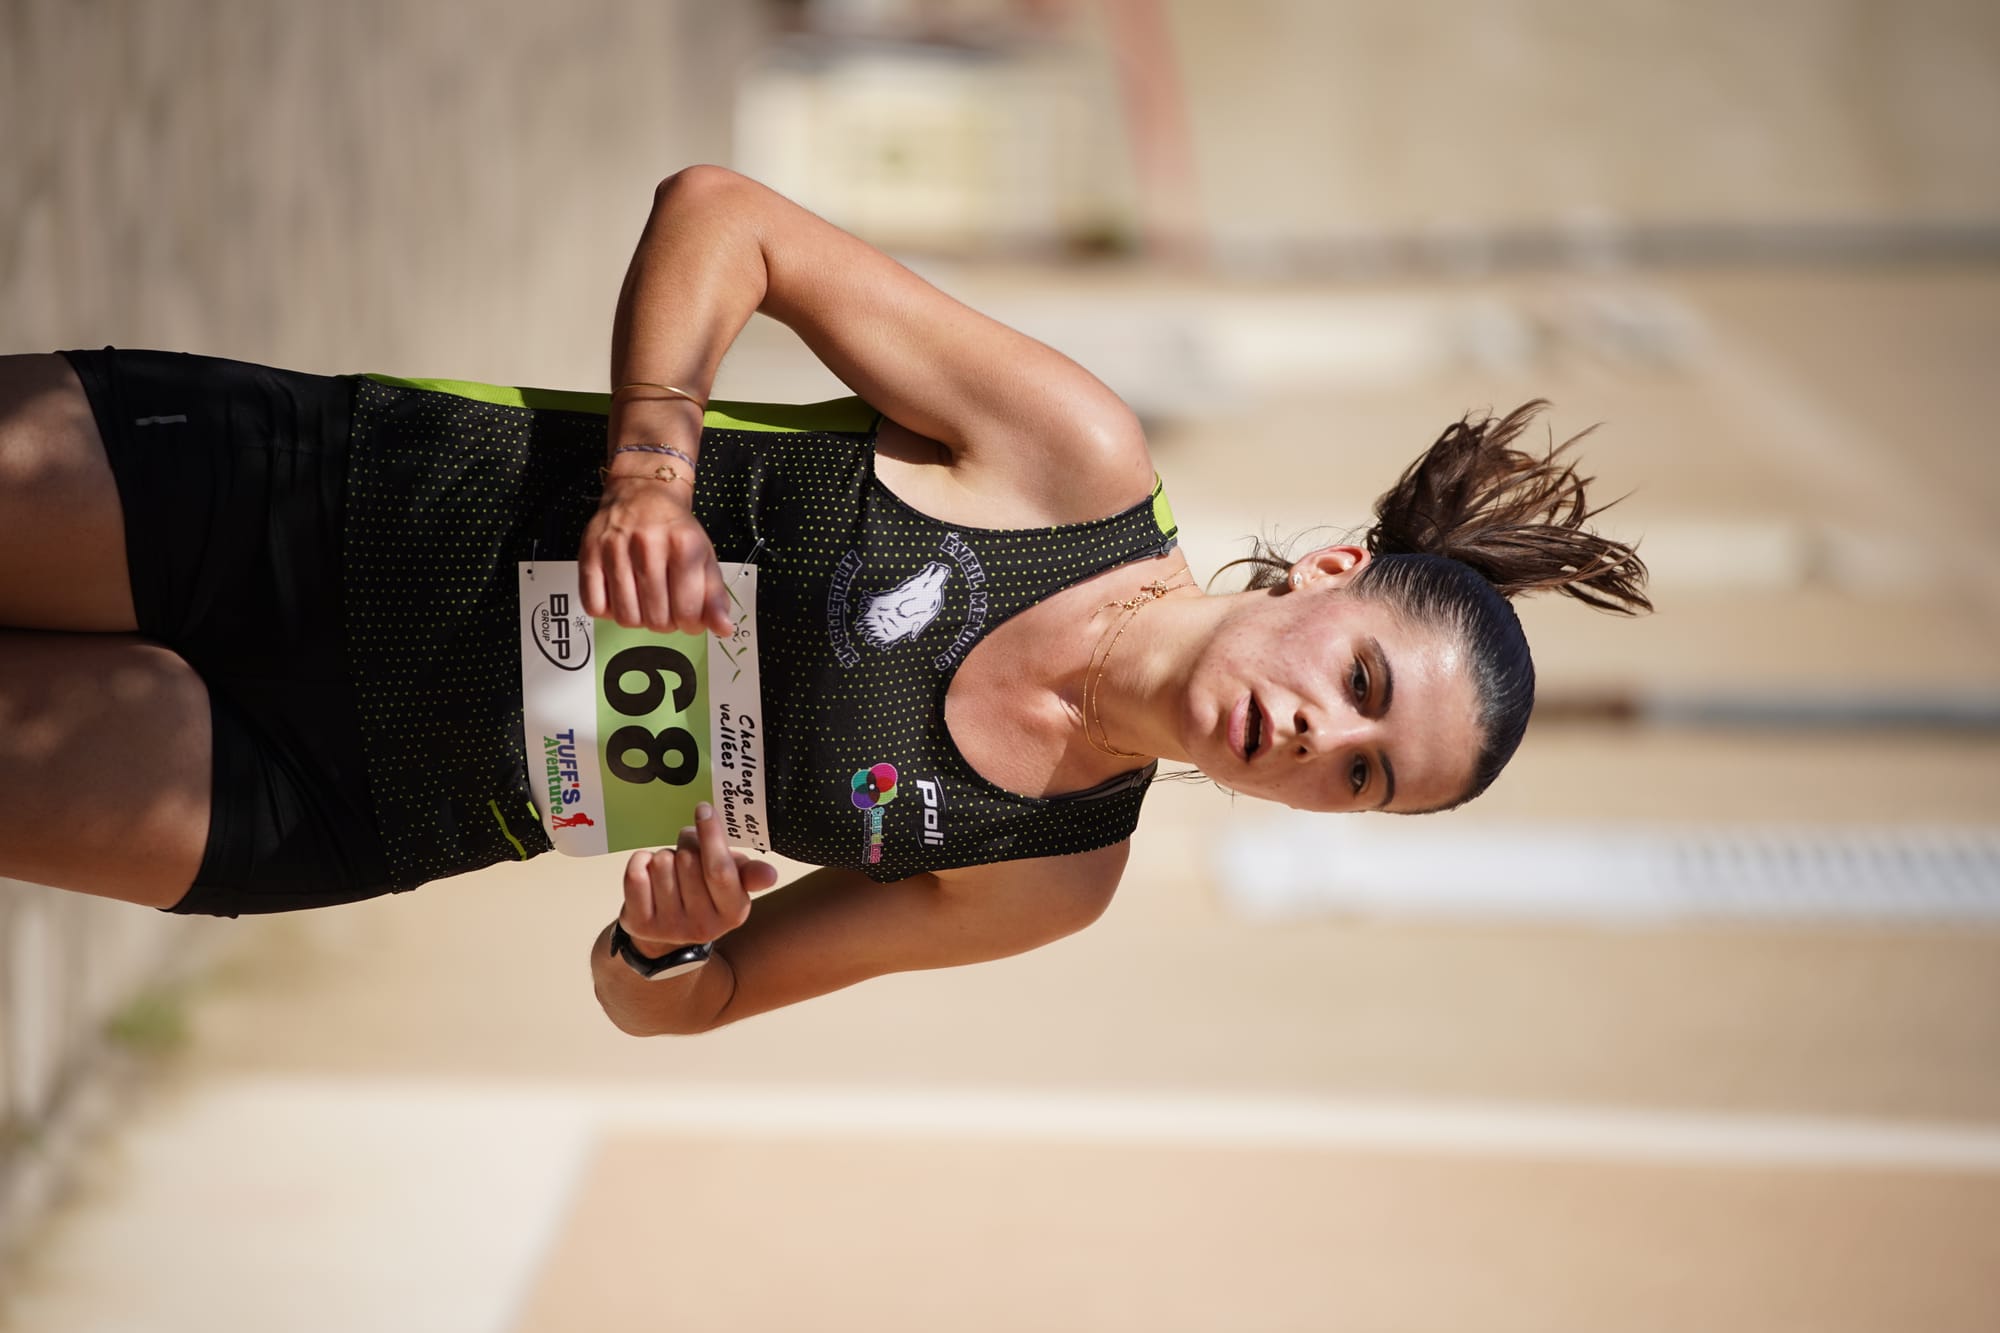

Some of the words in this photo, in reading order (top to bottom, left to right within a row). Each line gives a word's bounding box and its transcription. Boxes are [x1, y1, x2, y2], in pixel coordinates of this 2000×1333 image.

[940, 532, 986, 591] ÉVEIL
[540, 608, 551, 642] GROUP
[549, 593, 571, 660] BFP
[603, 645, 699, 786] 68
[720, 703, 738, 770] vallées
[543, 735, 564, 815] Aventure
[556, 728, 581, 805] TUFF'S
[737, 714, 757, 805] Challenge
[722, 781, 741, 839] cévenoles
[745, 814, 759, 835] des
